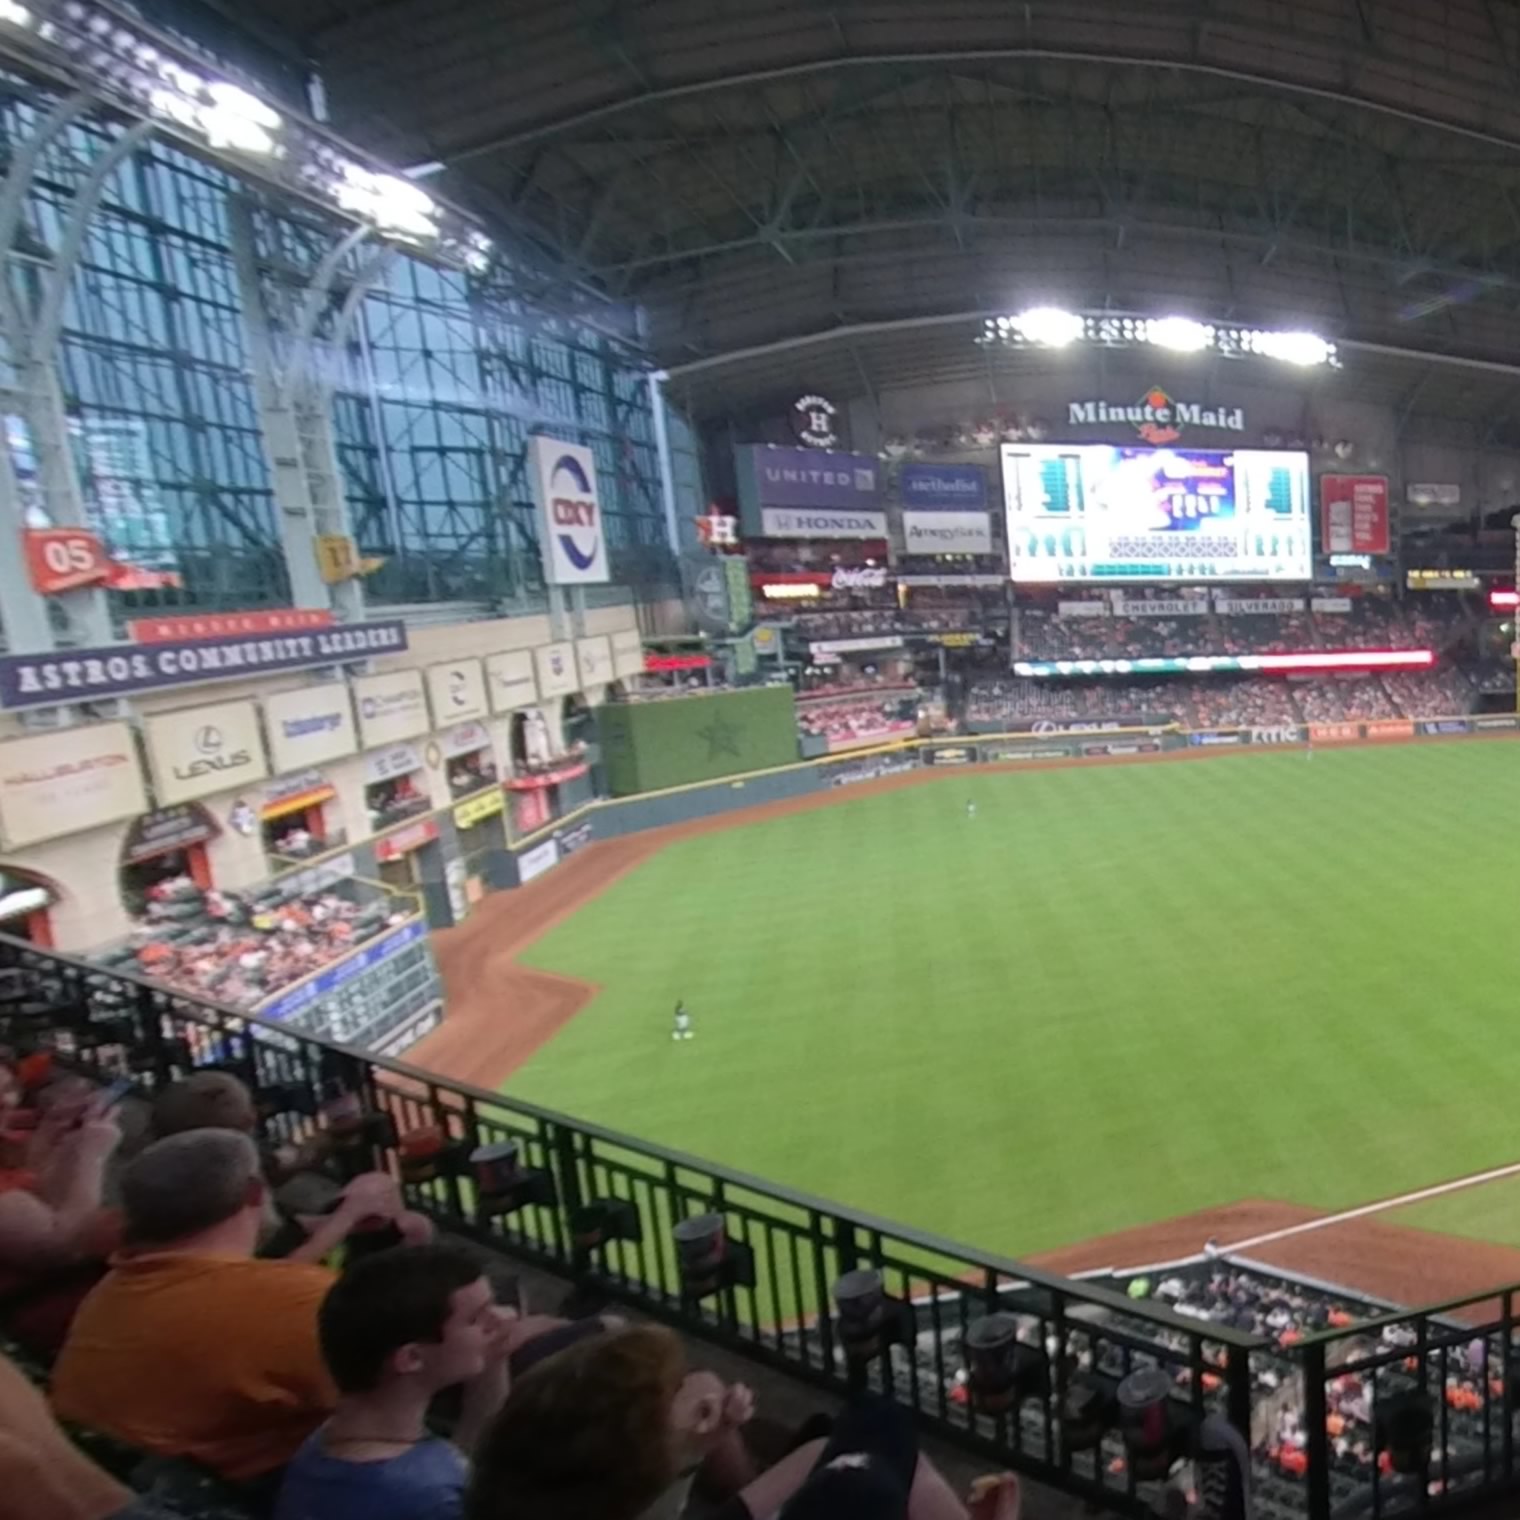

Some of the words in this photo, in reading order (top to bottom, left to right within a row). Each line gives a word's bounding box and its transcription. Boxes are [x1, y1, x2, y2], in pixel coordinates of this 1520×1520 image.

[1069, 402, 1171, 424] Minute
[1175, 403, 1244, 430] Maid
[765, 467, 851, 486] UNITED
[552, 498, 596, 528] OXY
[796, 517, 877, 532] HONDA
[44, 539, 96, 573] 05
[1122, 602, 1198, 614] CHEVROLET
[16, 654, 151, 693] ASTROS
[158, 637, 313, 675] COMMUNITY
[317, 627, 400, 654] LEADERS
[173, 750, 252, 780] LEXUS
